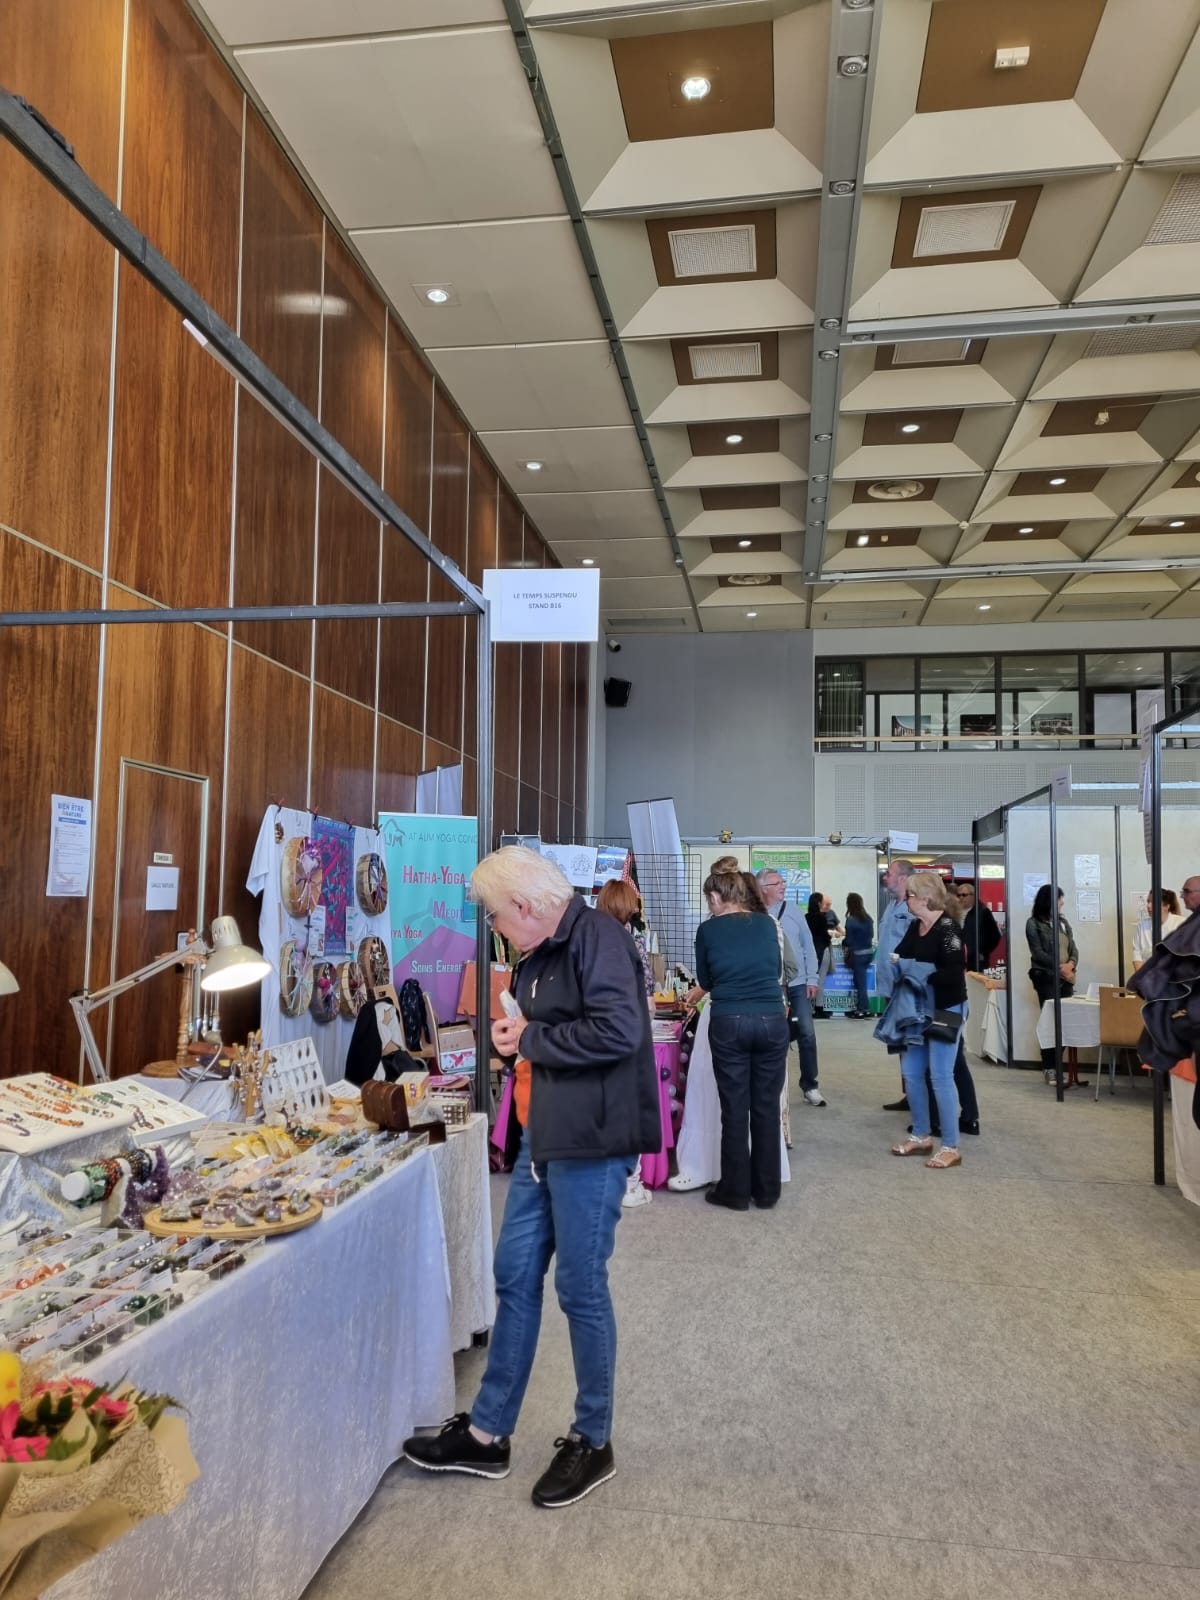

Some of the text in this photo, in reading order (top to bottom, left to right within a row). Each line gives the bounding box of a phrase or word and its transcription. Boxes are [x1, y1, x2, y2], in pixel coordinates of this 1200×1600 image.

[435, 833, 456, 843] YOGA
[403, 925, 423, 939] YOGA
[411, 959, 433, 973] SOINS
